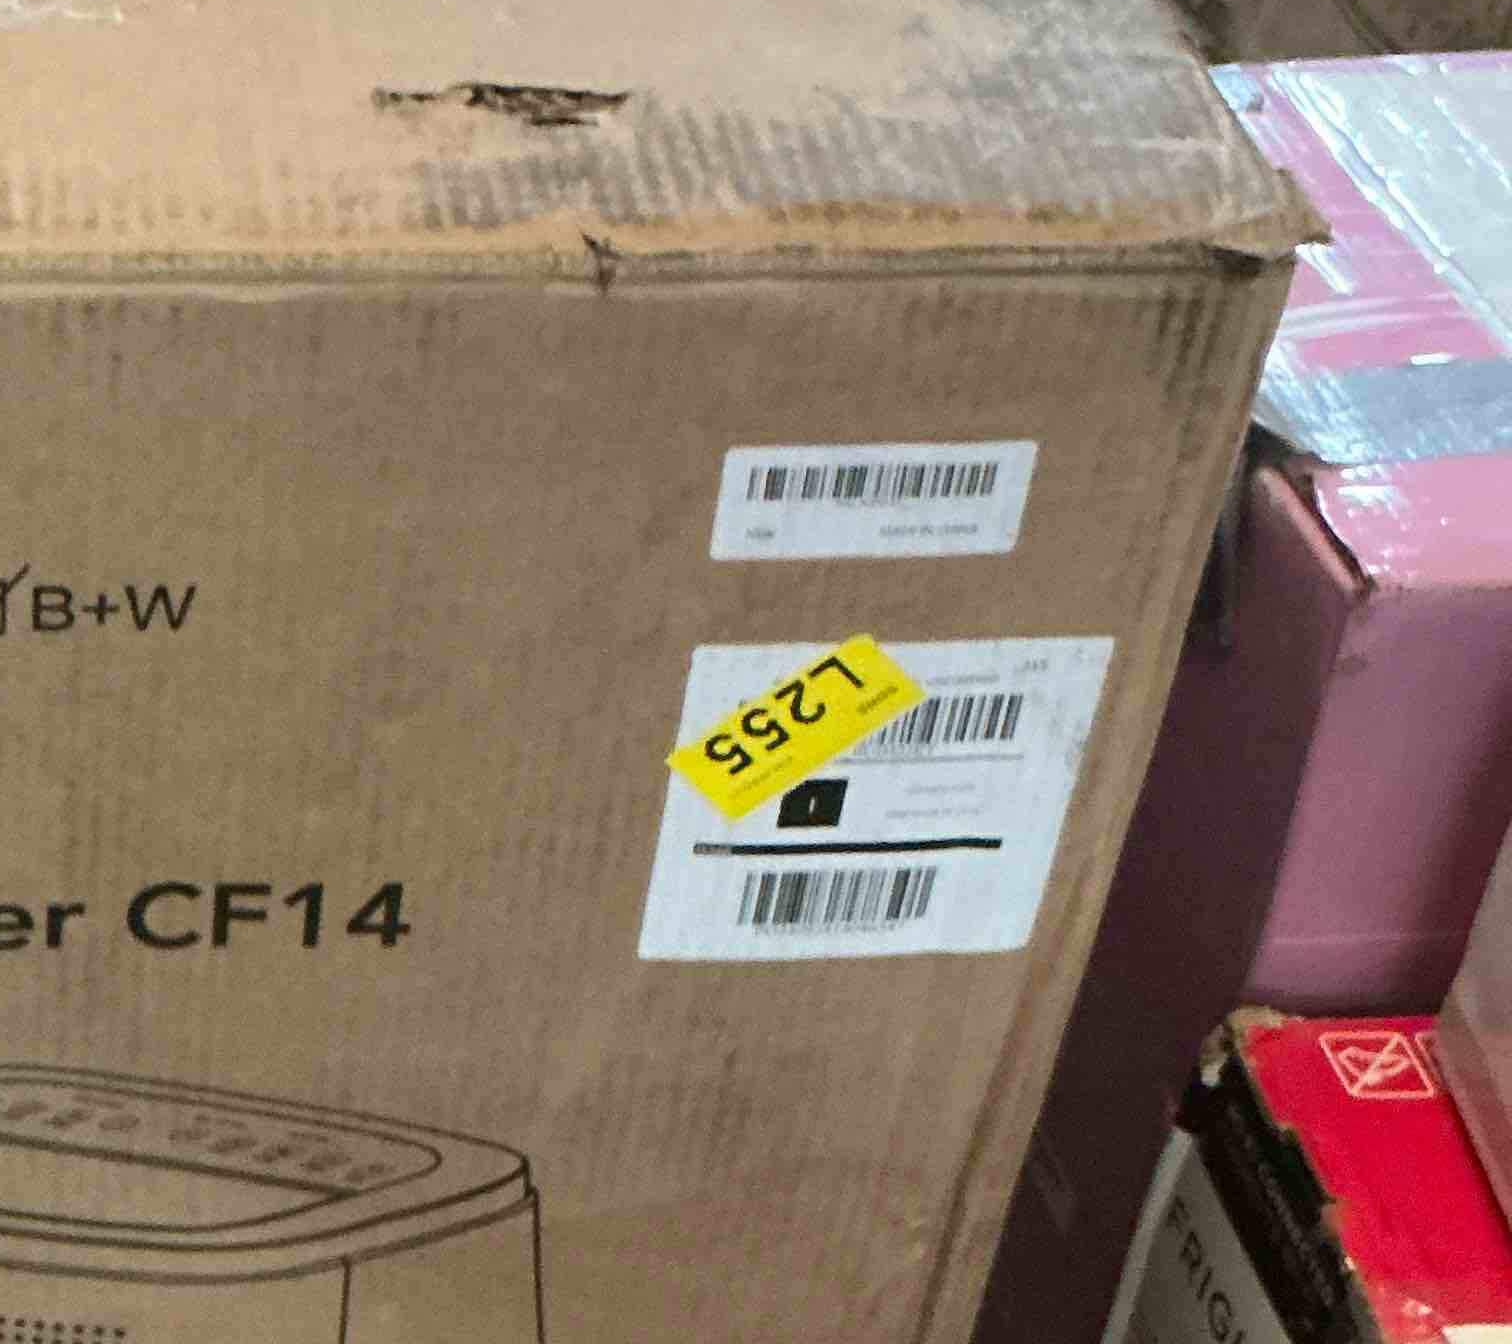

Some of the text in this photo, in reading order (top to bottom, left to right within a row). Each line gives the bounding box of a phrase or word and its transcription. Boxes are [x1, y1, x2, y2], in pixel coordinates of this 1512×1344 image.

[31, 583, 198, 632] B+W
[702, 655, 866, 776] L255
[122, 880, 414, 951] CF14
